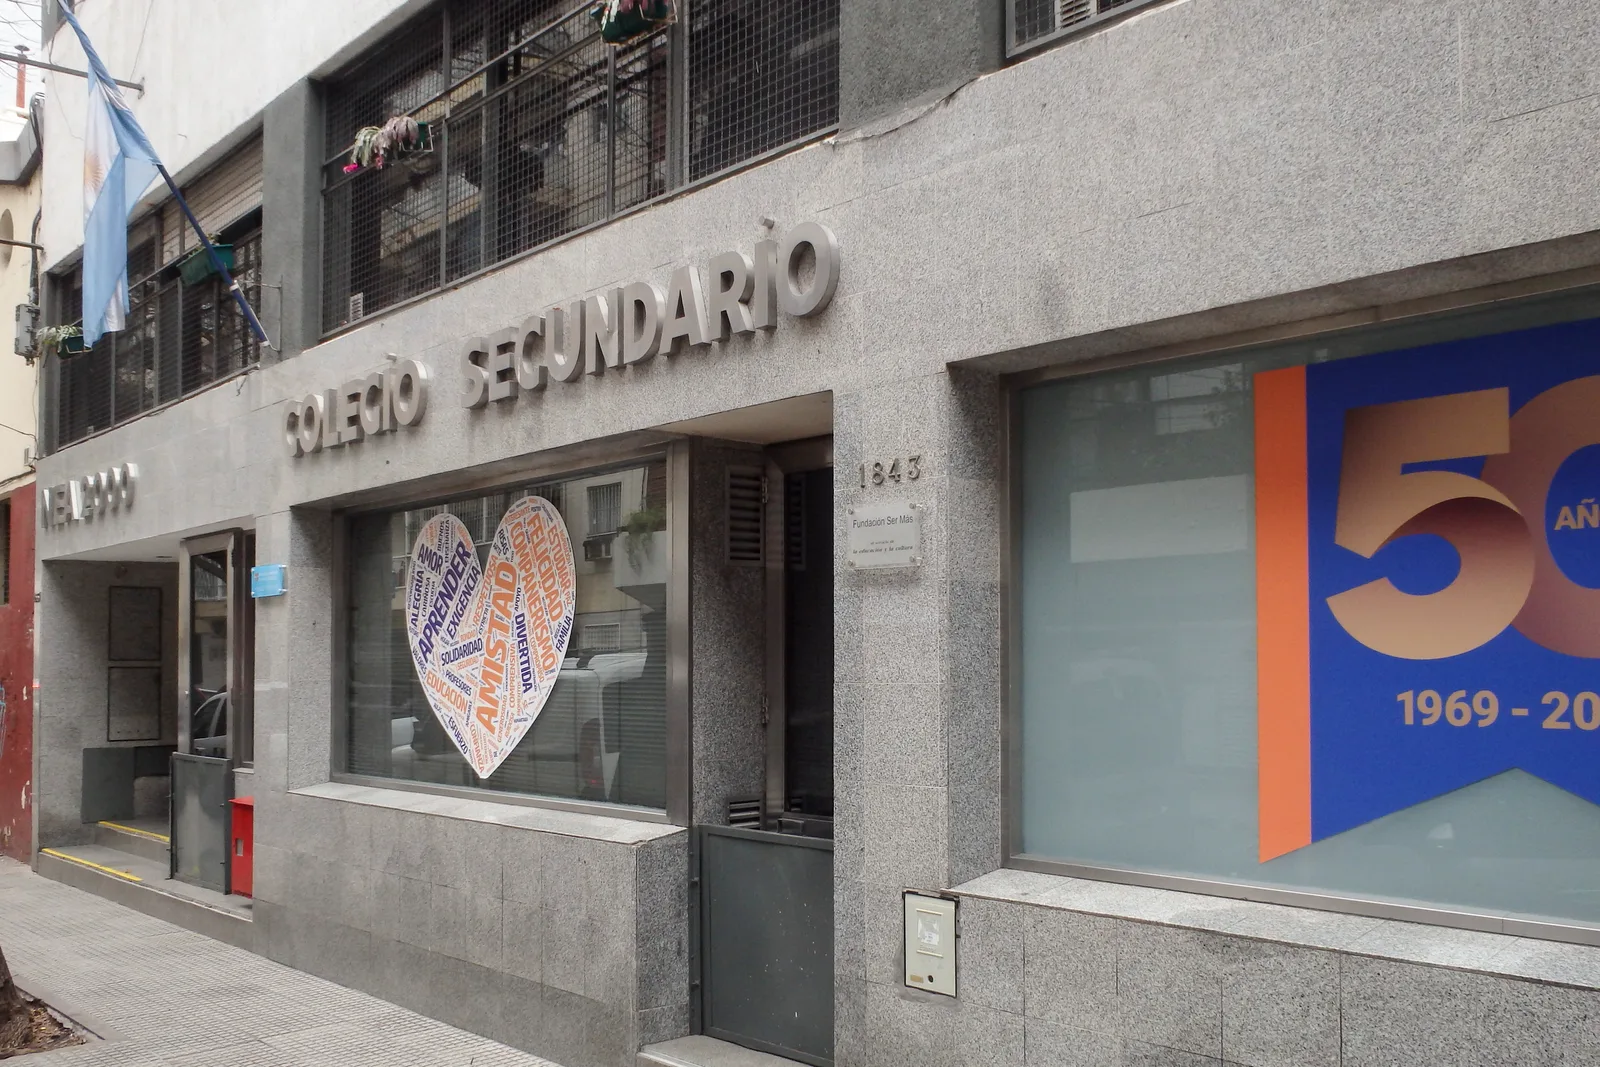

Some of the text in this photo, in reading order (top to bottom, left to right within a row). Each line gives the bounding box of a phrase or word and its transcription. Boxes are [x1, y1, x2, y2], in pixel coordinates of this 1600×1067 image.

[282, 216, 840, 458] COLEGIO SECUNDARIO
[859, 456, 920, 489] 1843
[498, 528, 509, 555] RISAS
[852, 518, 885, 528] Fundación
[886, 516, 898, 526] Ser
[418, 543, 443, 576] AMOR
[473, 555, 498, 626] RESPETUOSA
[527, 512, 563, 622] FELICIDAD
[548, 524, 571, 593] ESTUDIAR
[418, 540, 472, 663] APRENDER
[447, 565, 480, 640] EXIGENCIA
[511, 521, 555, 671] COMPAÑERISMO
[441, 637, 483, 666] SOLIDARIDAD
[476, 561, 517, 735] AMISTAD
[515, 612, 532, 693] DIVERTIDA
[555, 615, 573, 652] FAMILIA
[448, 716, 468, 755] ESFUERZO
[1396, 690, 1498, 726] 1969
